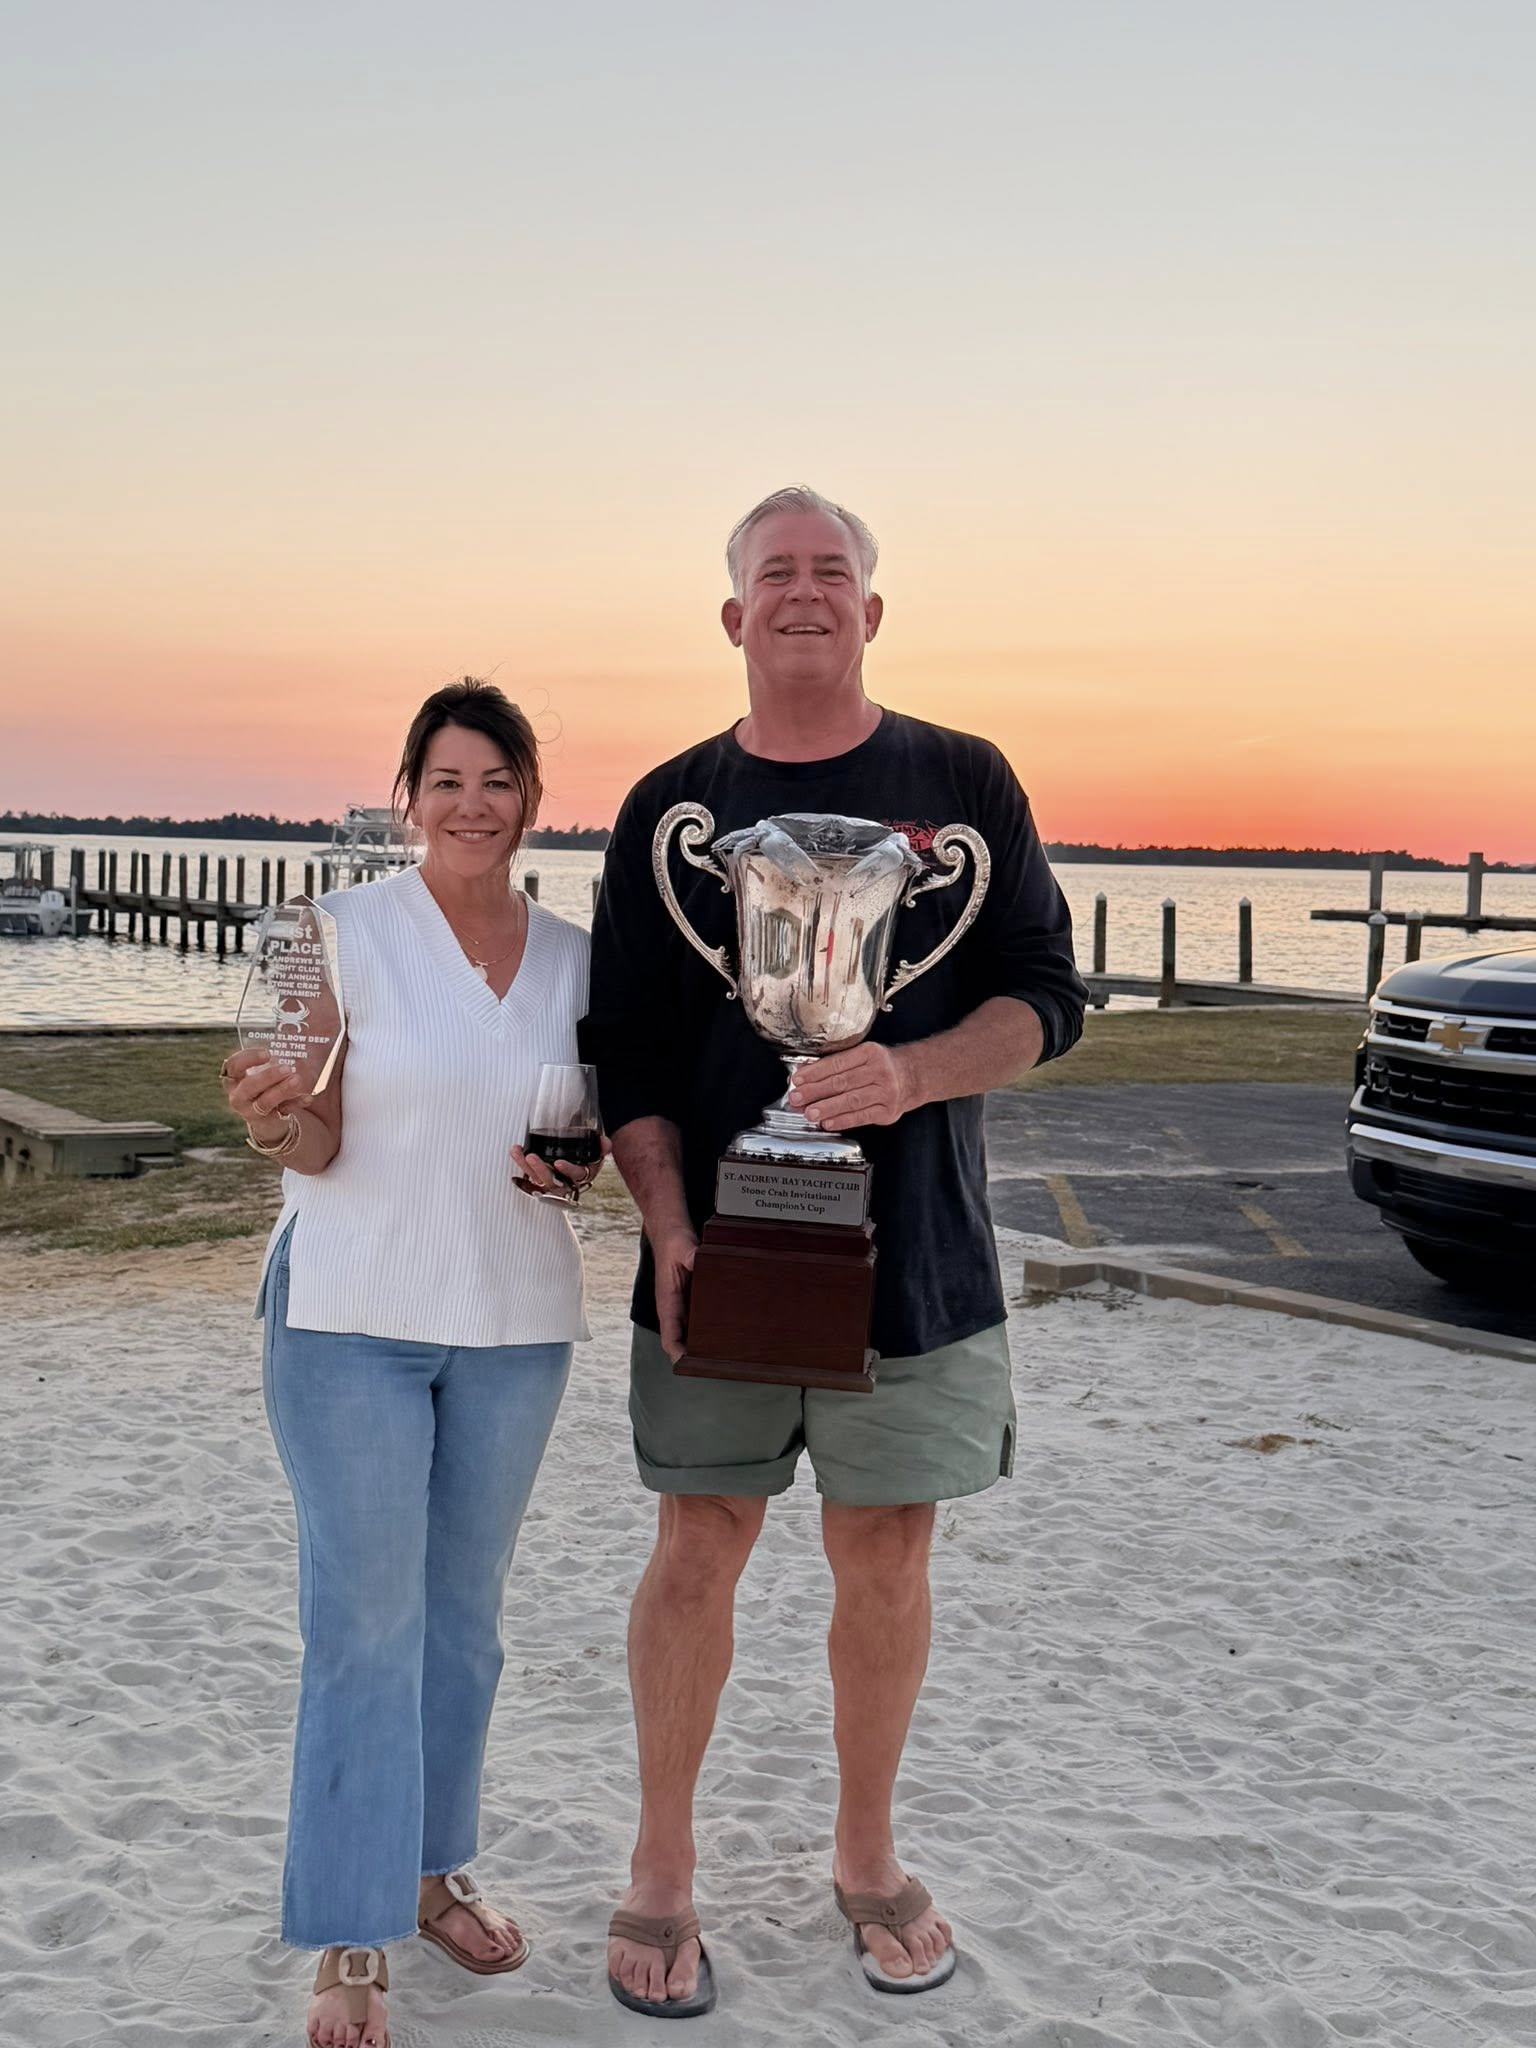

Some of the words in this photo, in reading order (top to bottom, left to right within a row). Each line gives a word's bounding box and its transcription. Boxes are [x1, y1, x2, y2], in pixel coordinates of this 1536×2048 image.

[290, 924, 313, 940] st
[269, 940, 322, 955] PLACE
[298, 966, 321, 974] CLUB
[287, 973, 322, 982] ANNUAL
[268, 979, 295, 988] TONE
[277, 1033, 307, 1042] ELBOW
[308, 1035, 330, 1044] DEEP
[270, 1041, 288, 1049] FOR
[289, 1042, 307, 1050] THE
[278, 1058, 296, 1066] CUP
[738, 1174, 780, 1184] ANDREW
[782, 1177, 800, 1186] BAY
[801, 1179, 833, 1190] YACHT
[834, 1182, 860, 1192] CLUB
[741, 1186, 766, 1196] Stone
[768, 1188, 789, 1198] Crab
[790, 1190, 841, 1202] Invitational
[755, 1199, 806, 1213] Champion's
[807, 1203, 826, 1215] Cup
